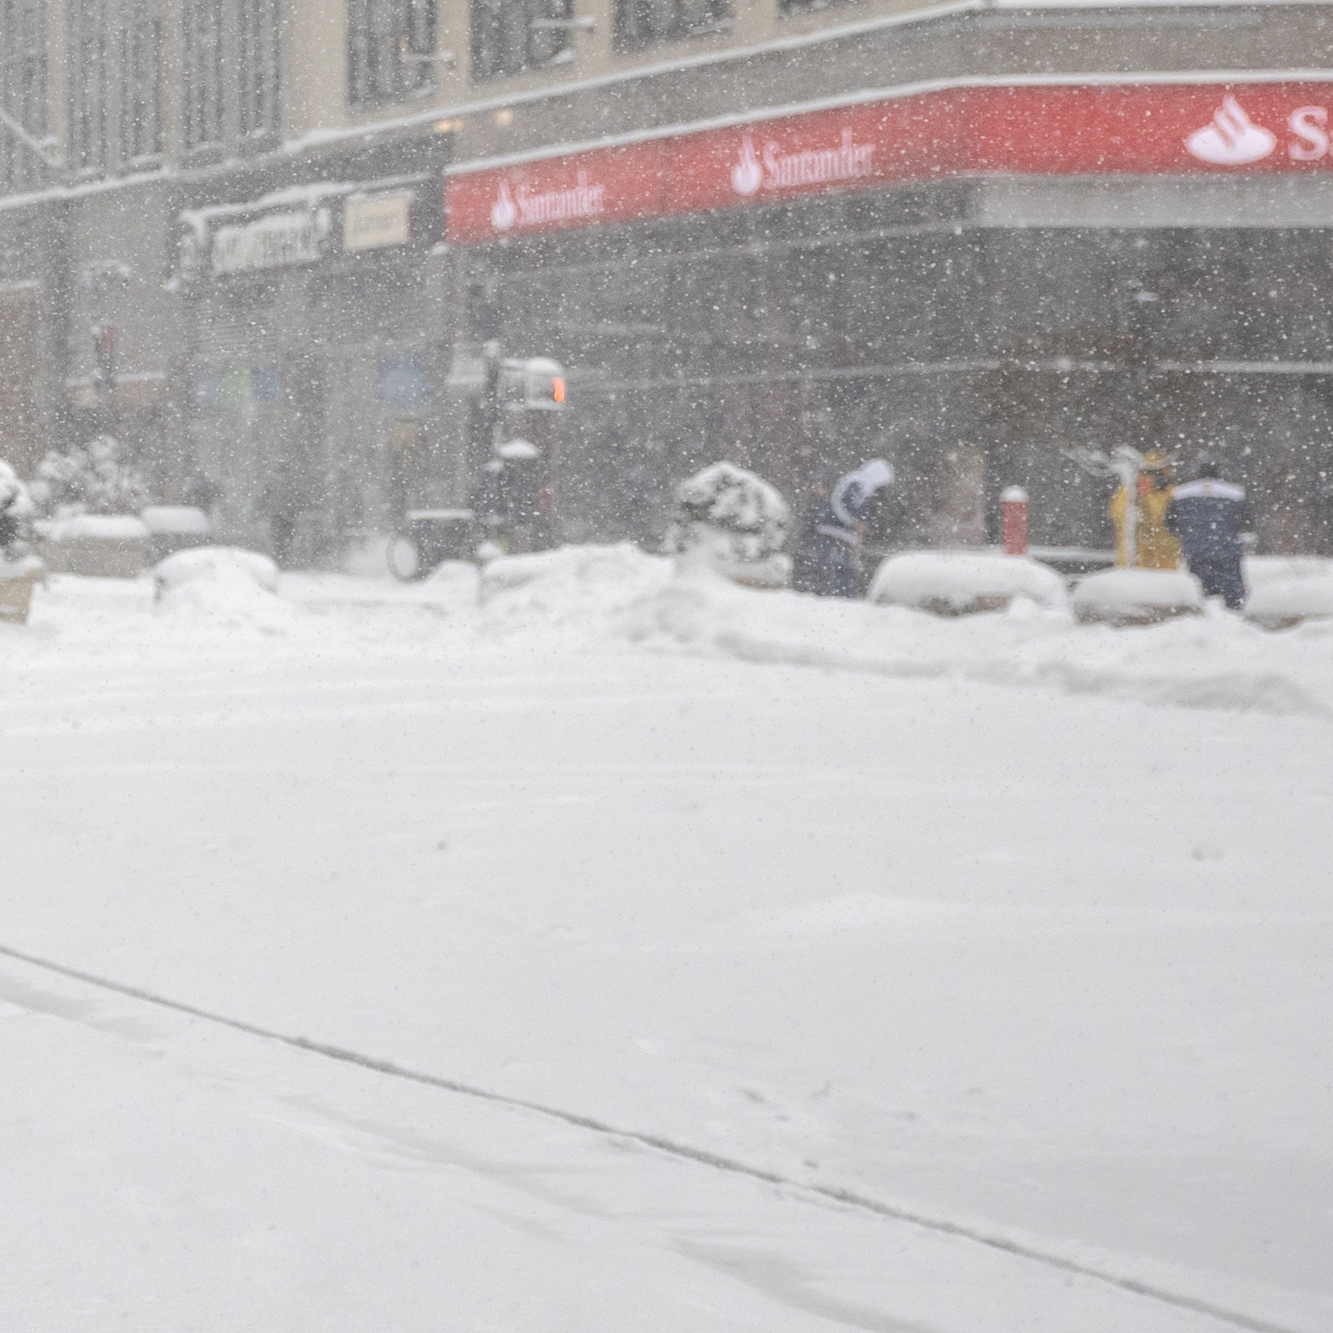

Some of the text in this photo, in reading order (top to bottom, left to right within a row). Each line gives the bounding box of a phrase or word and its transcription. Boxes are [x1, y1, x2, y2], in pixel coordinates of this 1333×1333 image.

[763, 126, 876, 190] Santander
[1286, 104, 1333, 162] S
[515, 168, 606, 226] Santander
